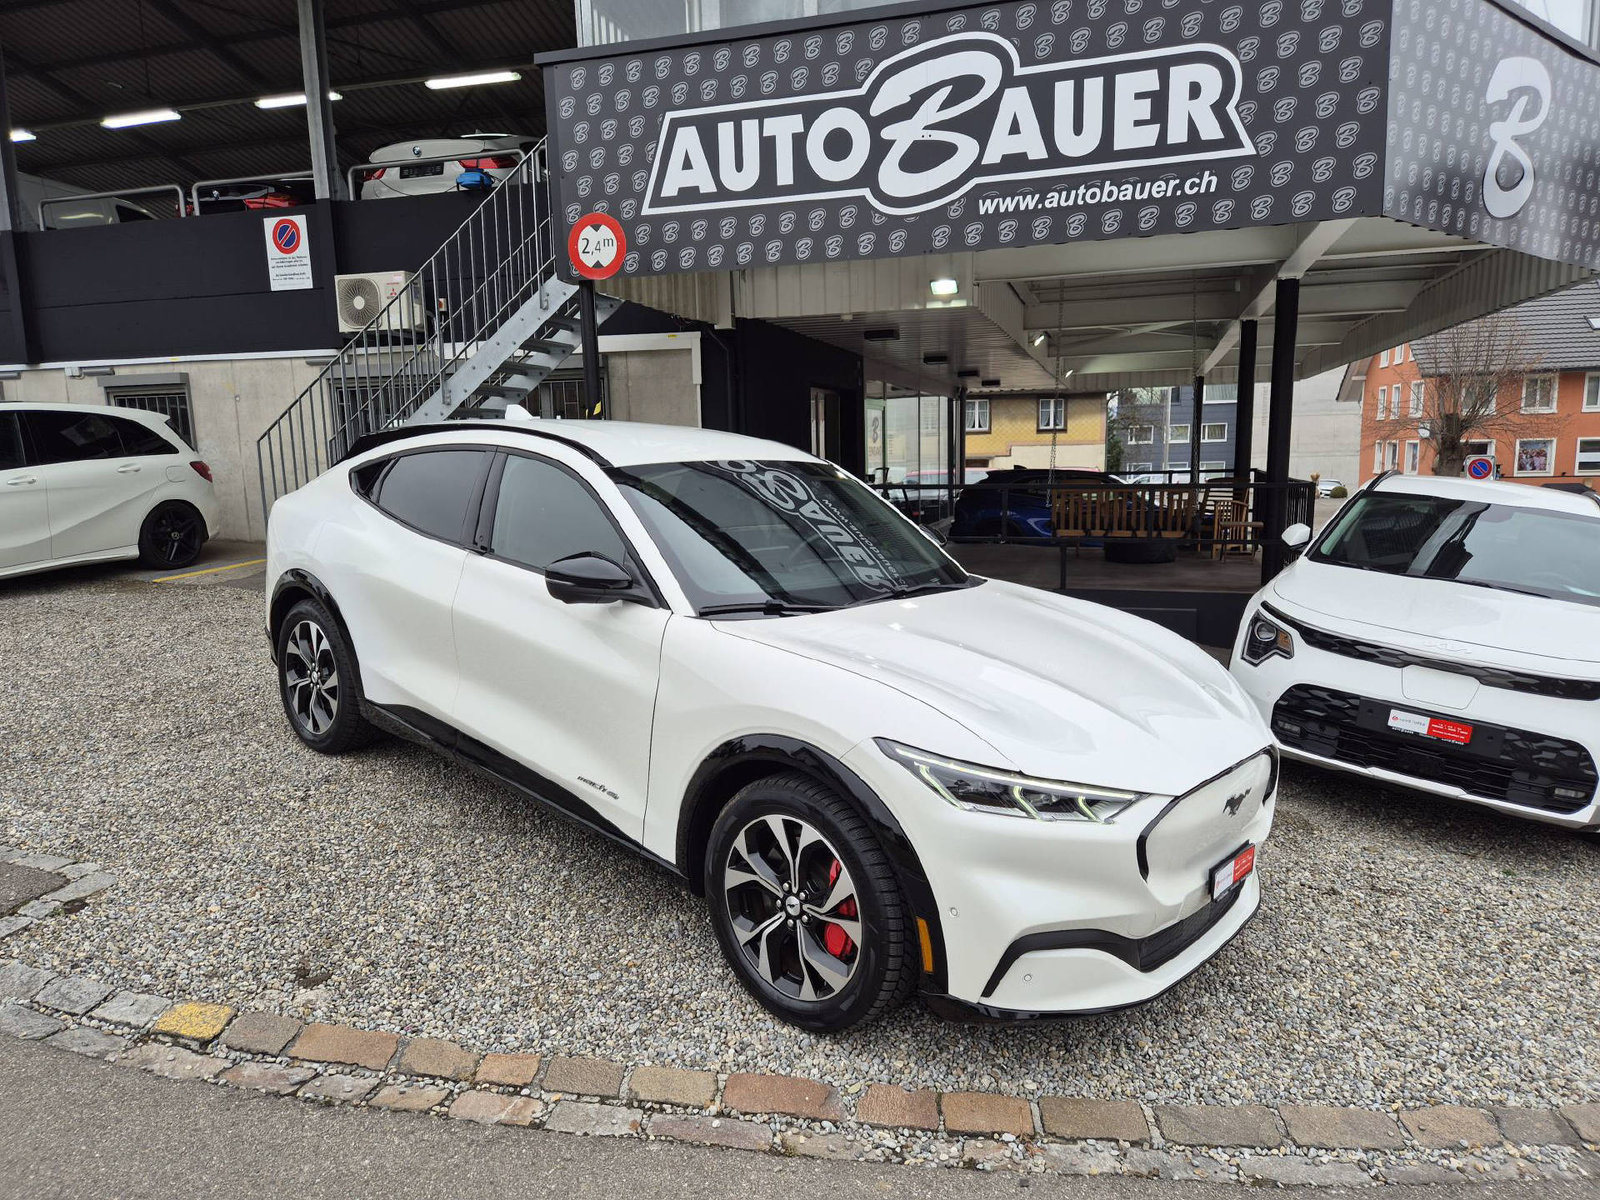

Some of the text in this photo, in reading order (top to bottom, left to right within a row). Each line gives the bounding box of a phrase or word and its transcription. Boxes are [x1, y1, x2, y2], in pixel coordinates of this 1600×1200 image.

[660, 51, 1224, 198] AUTO BAUER
[978, 170, 1218, 215] www.autobauer.ch
[1483, 57, 1550, 218] B
